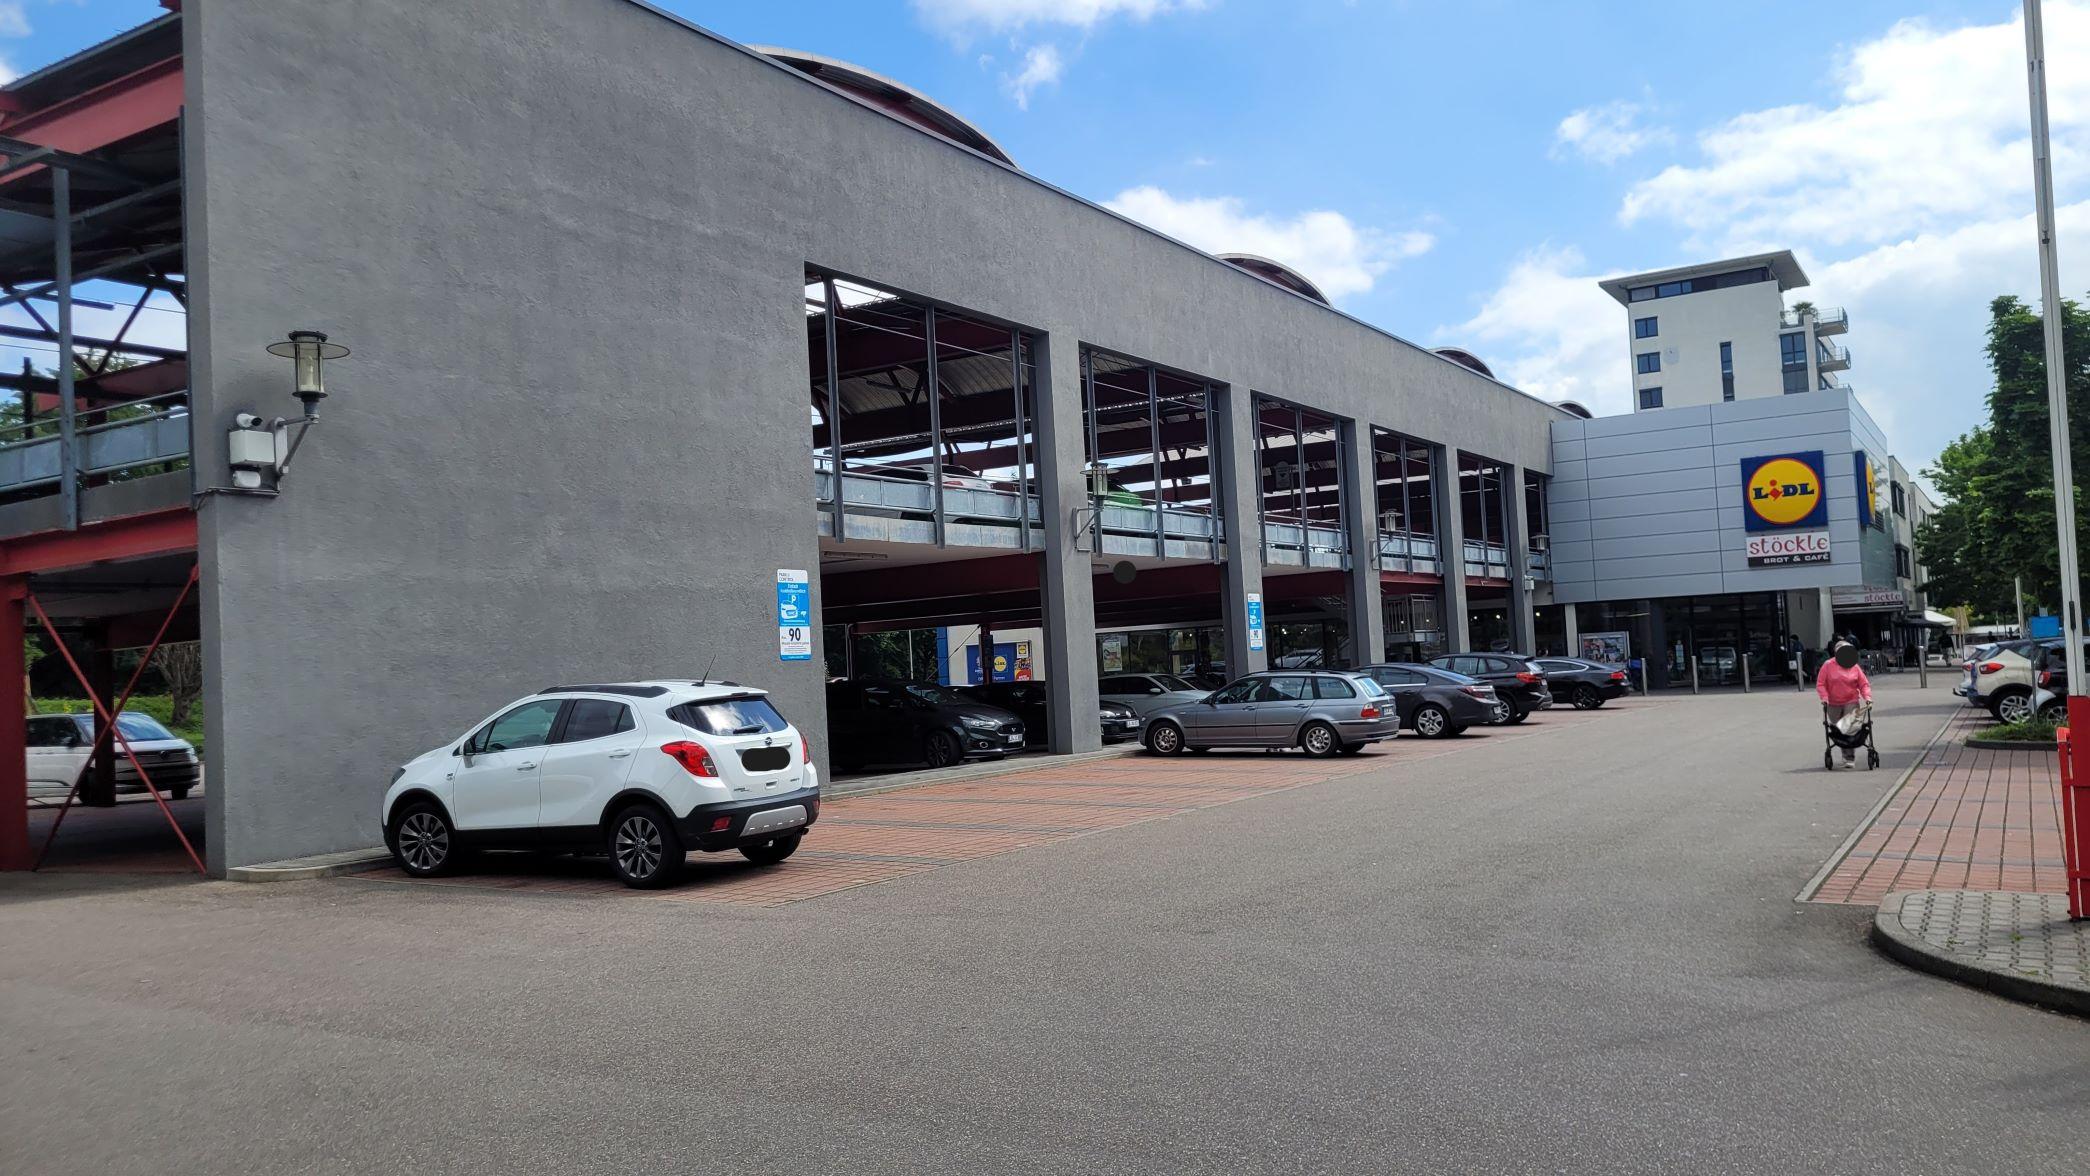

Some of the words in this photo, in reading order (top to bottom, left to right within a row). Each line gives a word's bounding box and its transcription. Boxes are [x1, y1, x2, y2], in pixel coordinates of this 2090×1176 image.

[1749, 534, 1828, 556] stöckle
[1763, 556, 1789, 564] BROT
[1804, 553, 1829, 561] CAFÉ
[788, 627, 801, 642] 90
